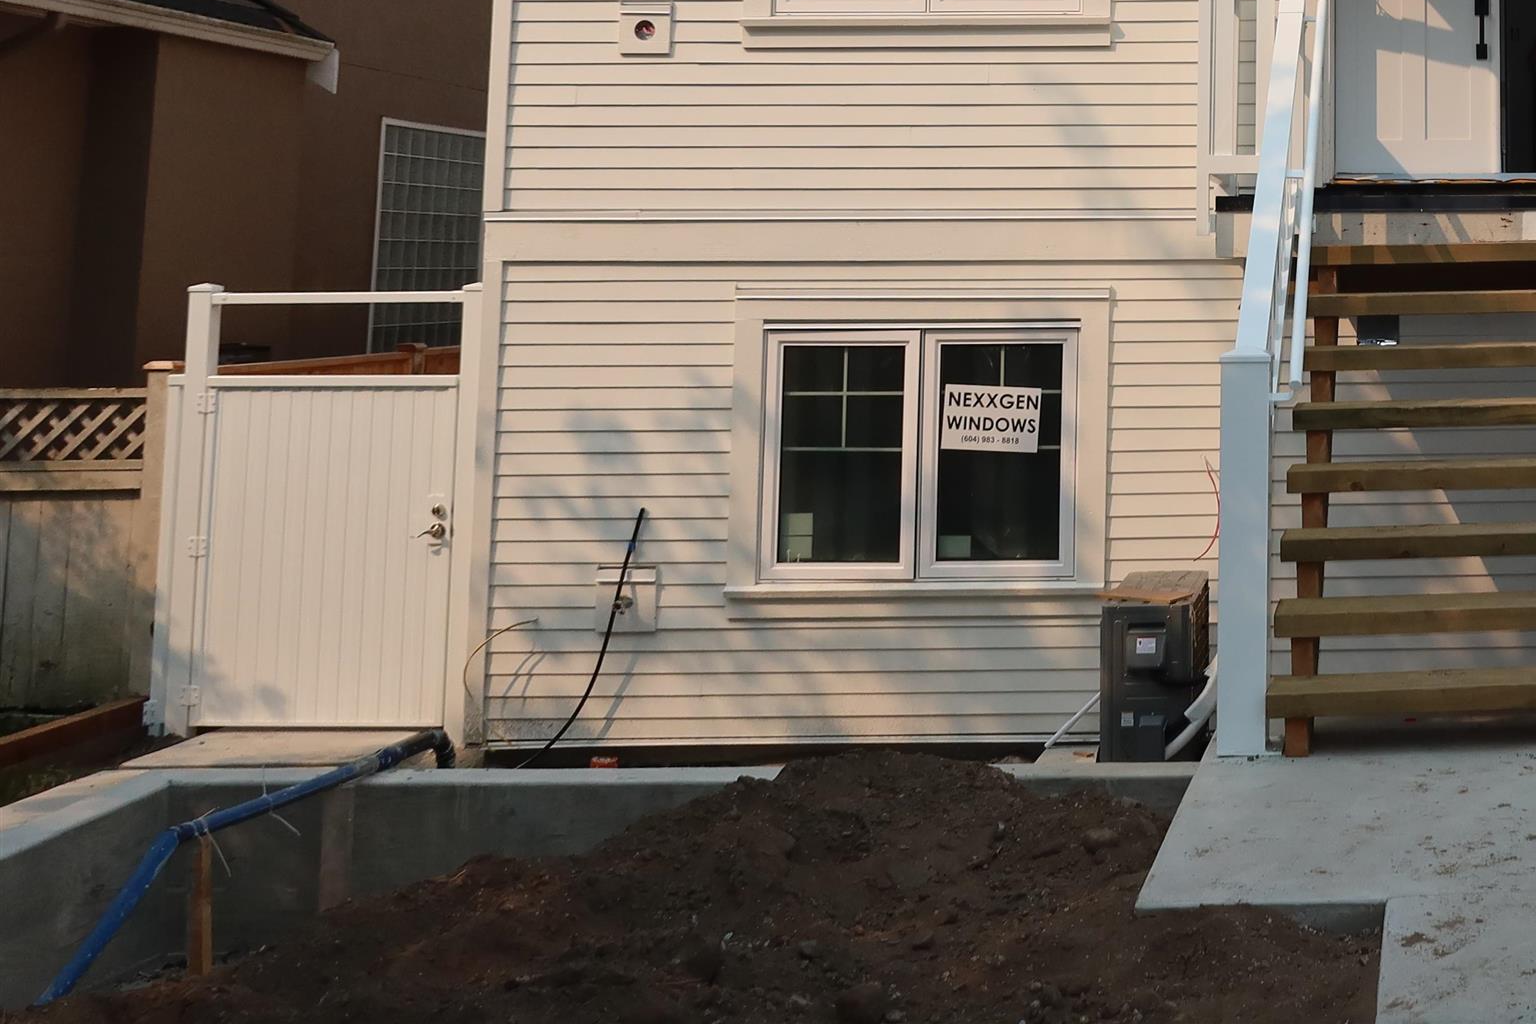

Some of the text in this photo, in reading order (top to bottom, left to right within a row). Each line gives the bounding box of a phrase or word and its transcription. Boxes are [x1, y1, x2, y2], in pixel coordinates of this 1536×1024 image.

[949, 391, 1039, 410] NEXXGEN
[947, 415, 1036, 434] WINDOWS
[961, 435, 980, 444] (604)
[982, 436, 995, 444] 983
